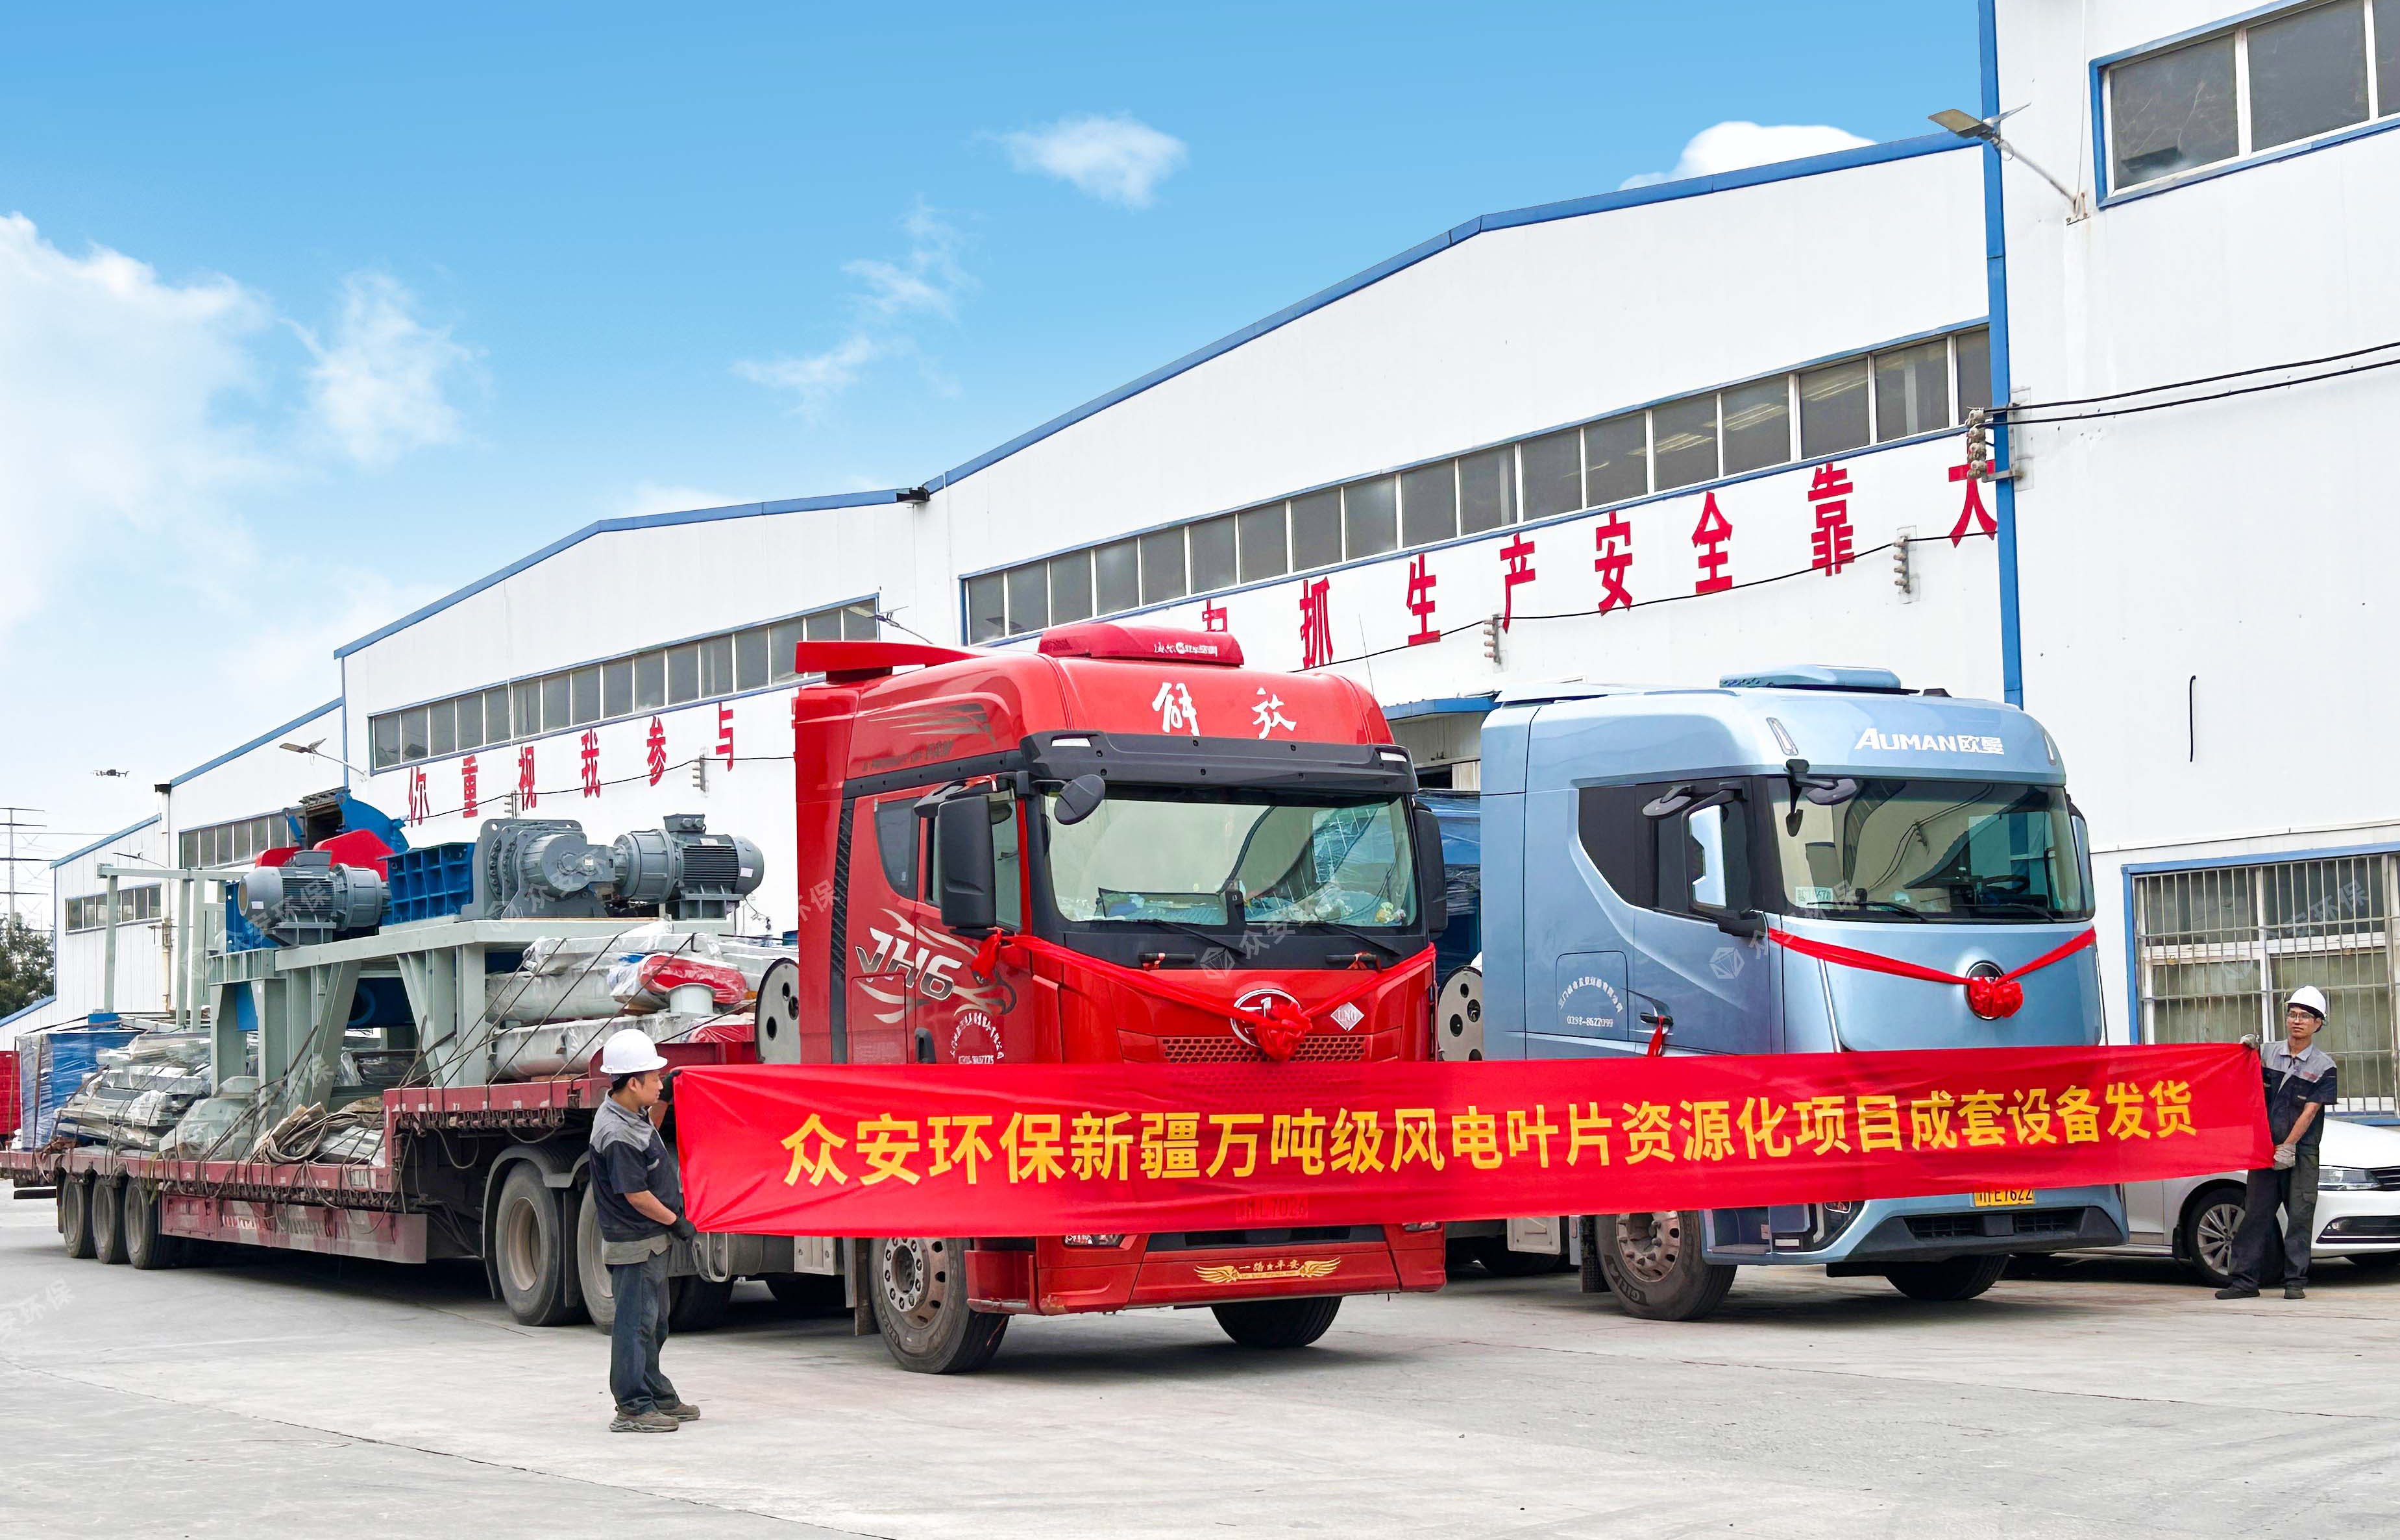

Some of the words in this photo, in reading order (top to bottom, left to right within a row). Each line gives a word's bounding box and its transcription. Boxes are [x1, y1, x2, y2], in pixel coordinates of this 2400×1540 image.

[781, 1079, 2197, 1187] 众安环保新疆万吨级风电叶片资源化项目成套设备发货
